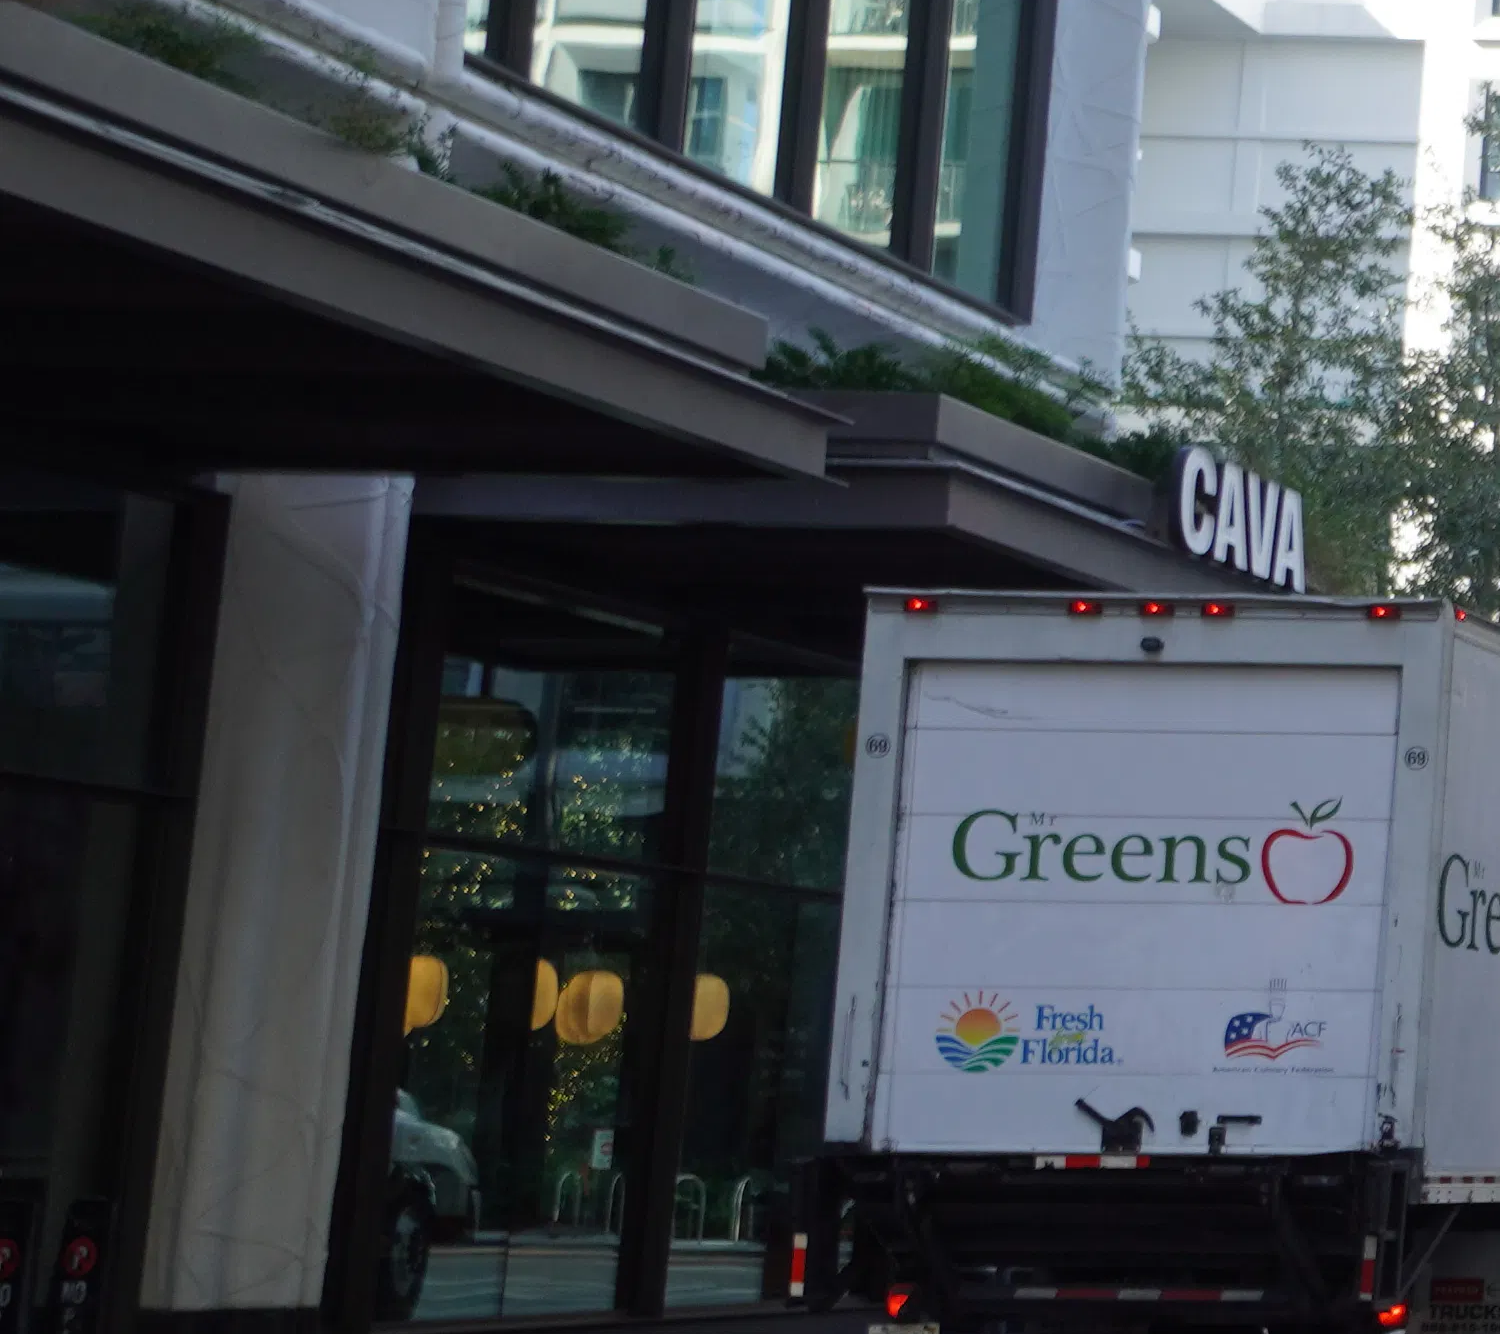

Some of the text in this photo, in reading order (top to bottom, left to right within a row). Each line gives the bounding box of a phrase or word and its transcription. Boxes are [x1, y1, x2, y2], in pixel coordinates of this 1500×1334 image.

[1179, 444, 1306, 595] CAVA
[869, 739, 888, 754] 69
[1407, 751, 1427, 767] 69
[1030, 812, 1058, 826] Mr
[951, 809, 1252, 884] Greens
[1035, 1004, 1105, 1032] Fresh
[1290, 1021, 1328, 1038] ACF
[61, 1280, 87, 1305] NO
